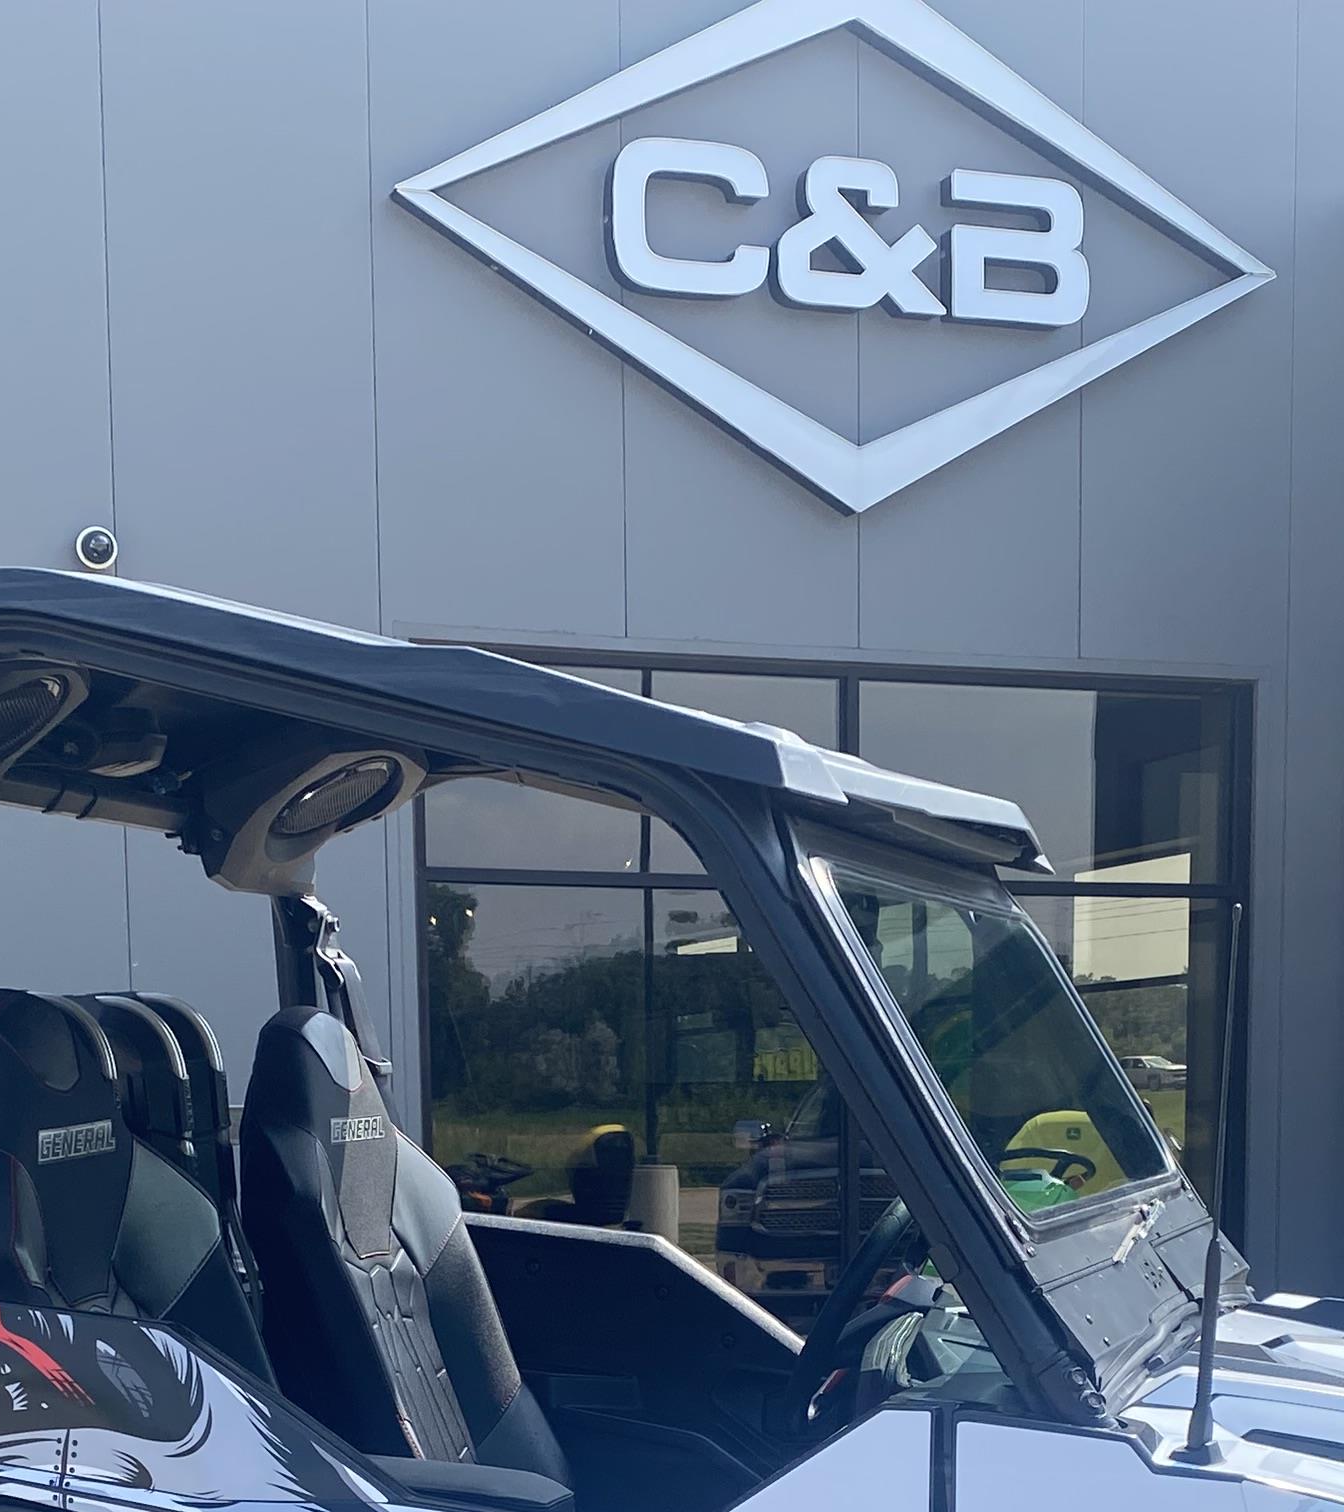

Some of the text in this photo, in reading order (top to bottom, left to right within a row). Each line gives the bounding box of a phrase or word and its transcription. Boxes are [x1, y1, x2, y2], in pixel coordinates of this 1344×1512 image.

[608, 136, 1090, 327] C&B
[38, 1120, 117, 1162] GENERAL
[330, 1115, 386, 1144] GENERAL
